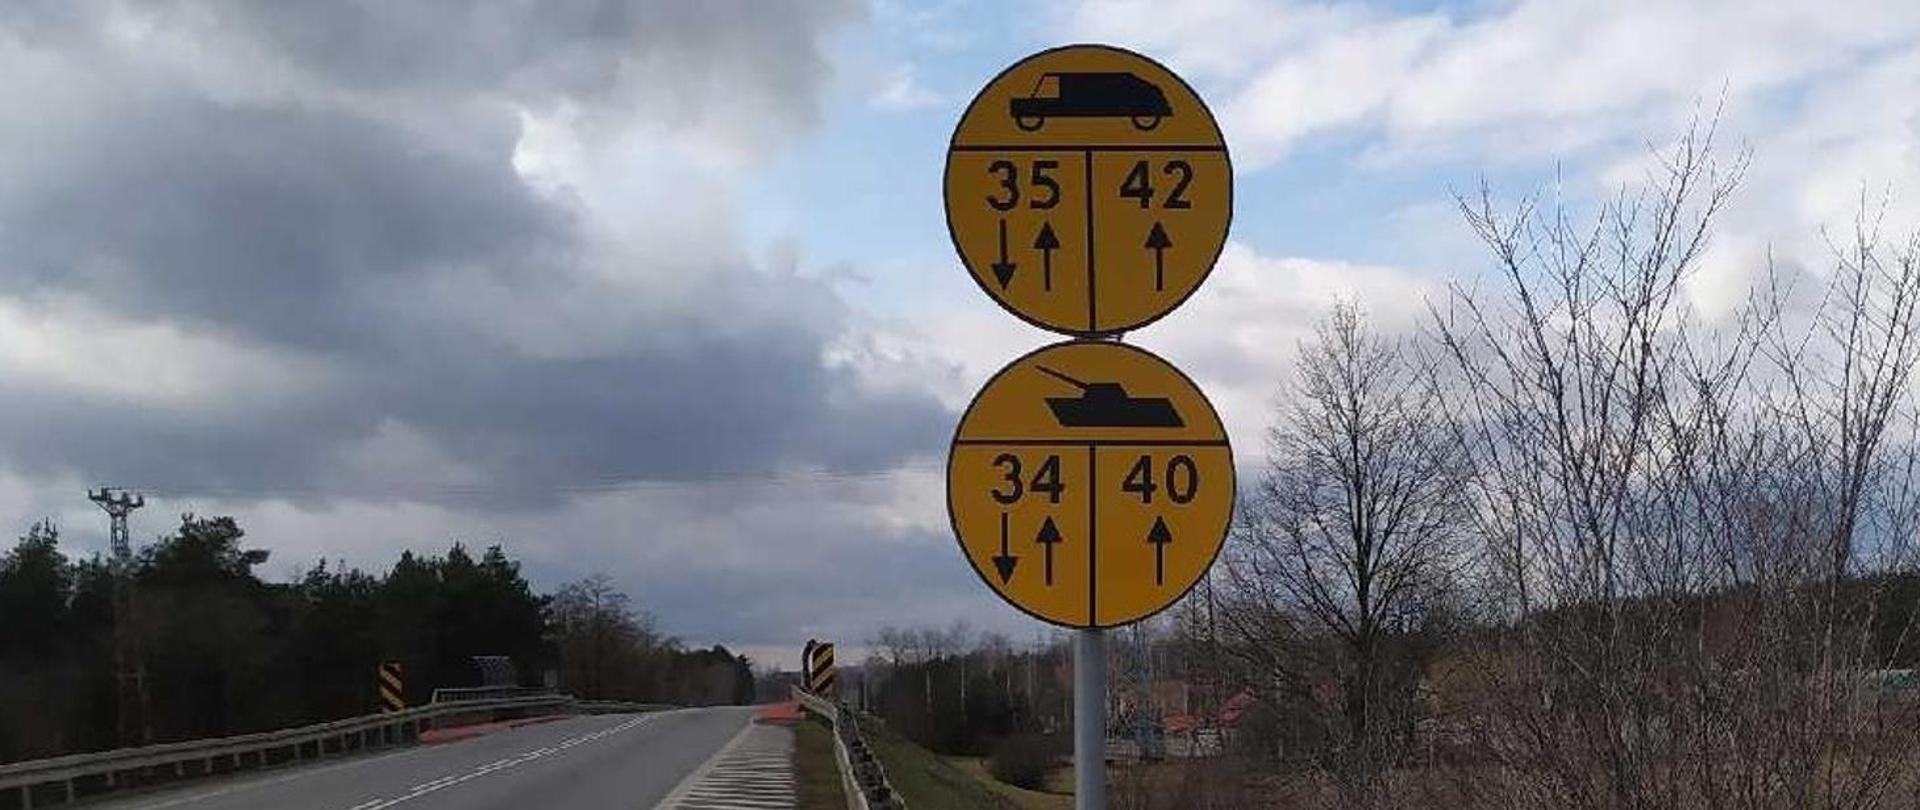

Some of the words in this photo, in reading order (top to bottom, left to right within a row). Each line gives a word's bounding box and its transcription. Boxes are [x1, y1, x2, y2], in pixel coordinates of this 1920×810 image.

[986, 160, 1061, 212] 35
[1120, 159, 1194, 210] 42
[991, 453, 1065, 505] 34
[1122, 454, 1198, 505] 40
